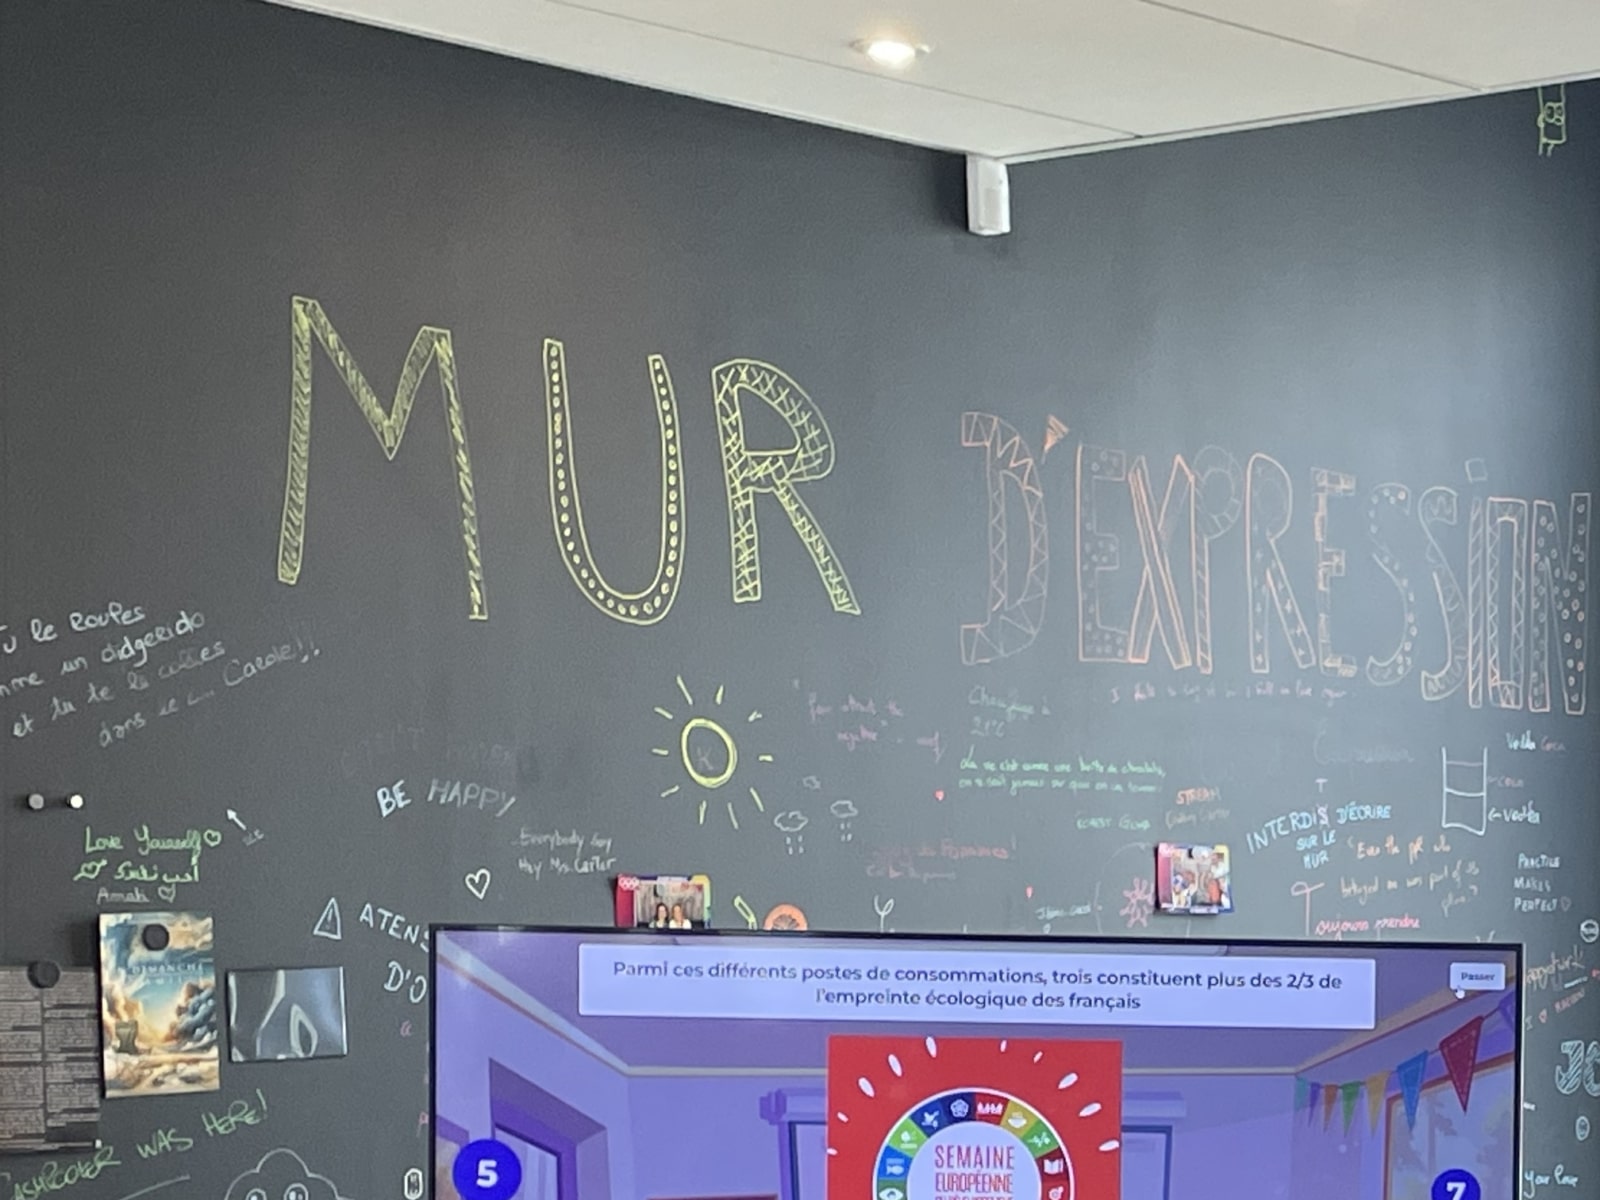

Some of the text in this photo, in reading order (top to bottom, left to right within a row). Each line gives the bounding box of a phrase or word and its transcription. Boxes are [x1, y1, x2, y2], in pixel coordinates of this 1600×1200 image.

[277, 295, 861, 625] MUR
[376, 778, 517, 818] BE HAPPY
[85, 826, 124, 854] Love
[1296, 830, 1336, 851] SUR LE
[1304, 853, 1330, 870] MUR
[613, 961, 1342, 990] Parmi ces différents postes de consommations, trois constituent plus des 2/3 de
[1461, 972, 1496, 981] Passer
[816, 987, 1142, 1012] l'empreinte écologique des français
[137, 1088, 268, 1159] WAS HERE!
[934, 1145, 1015, 1170] SEMAINE
[476, 1159, 499, 1188] 5
[935, 1170, 1013, 1193] EUROPÉENNE
